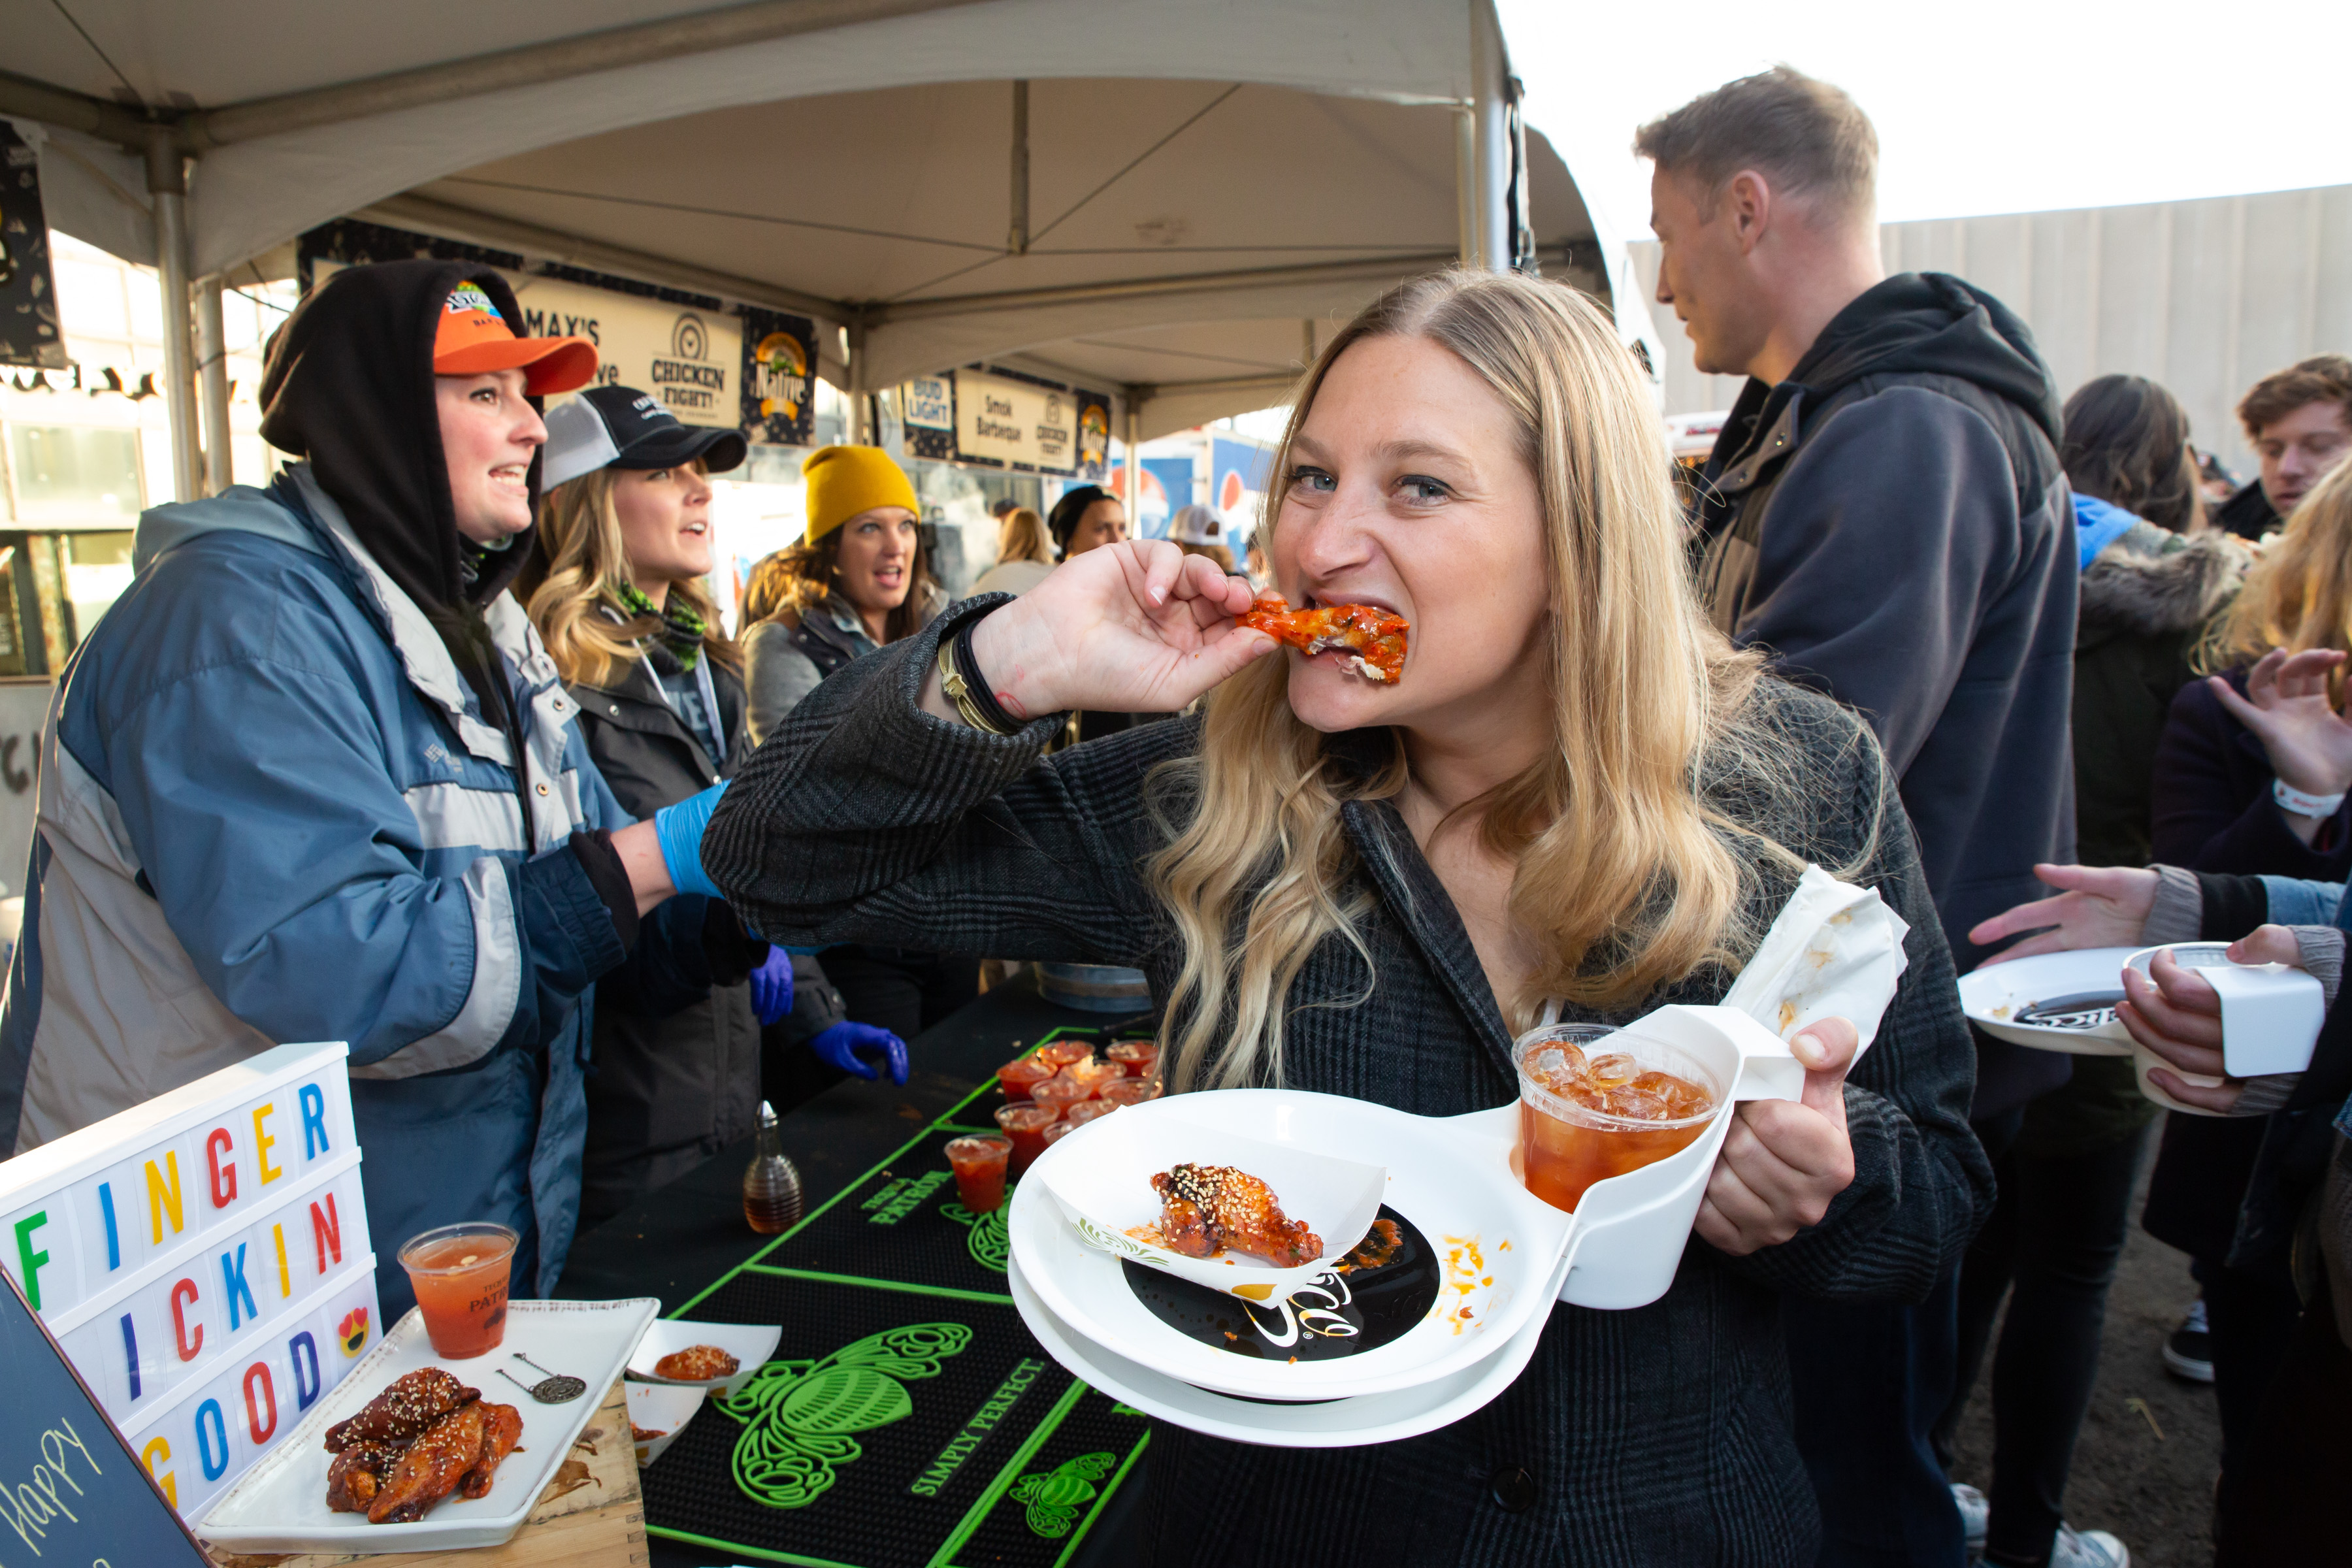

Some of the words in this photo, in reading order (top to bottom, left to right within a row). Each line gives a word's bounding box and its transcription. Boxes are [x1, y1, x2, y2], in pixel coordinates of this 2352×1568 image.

[652, 359, 725, 392] CHICKEN
[909, 399, 947, 423] LIGHT
[14, 1082, 331, 1312] FINGER
[142, 1330, 321, 1511] GOOD
[911, 1429, 983, 1497] SIMPLY
